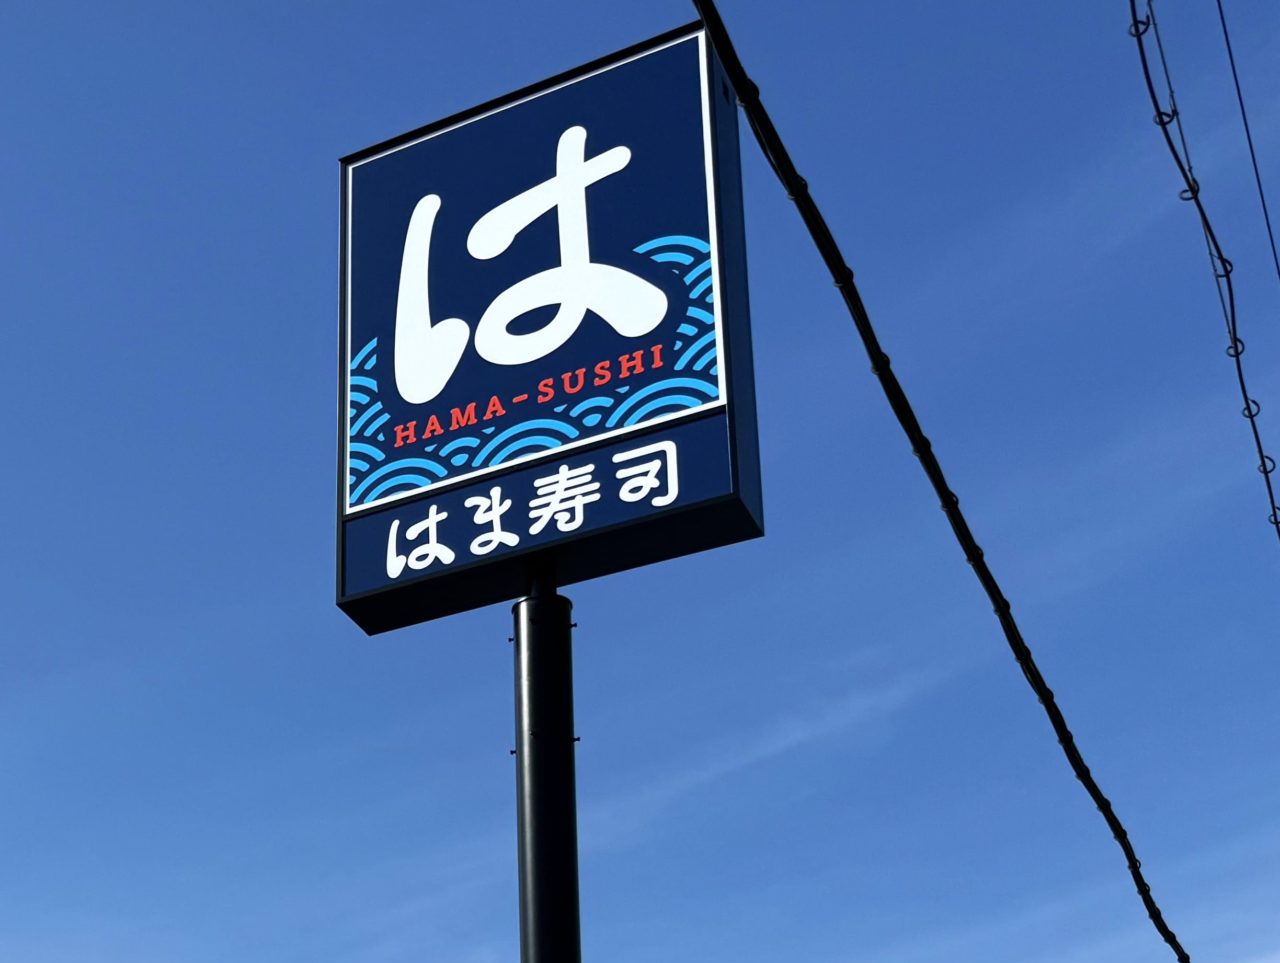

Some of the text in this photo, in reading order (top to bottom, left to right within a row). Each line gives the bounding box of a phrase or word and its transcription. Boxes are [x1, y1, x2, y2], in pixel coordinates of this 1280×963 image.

[394, 125, 668, 404] は
[393, 344, 665, 448] HAMA-SUSHI
[386, 440, 679, 579] はま寿司
